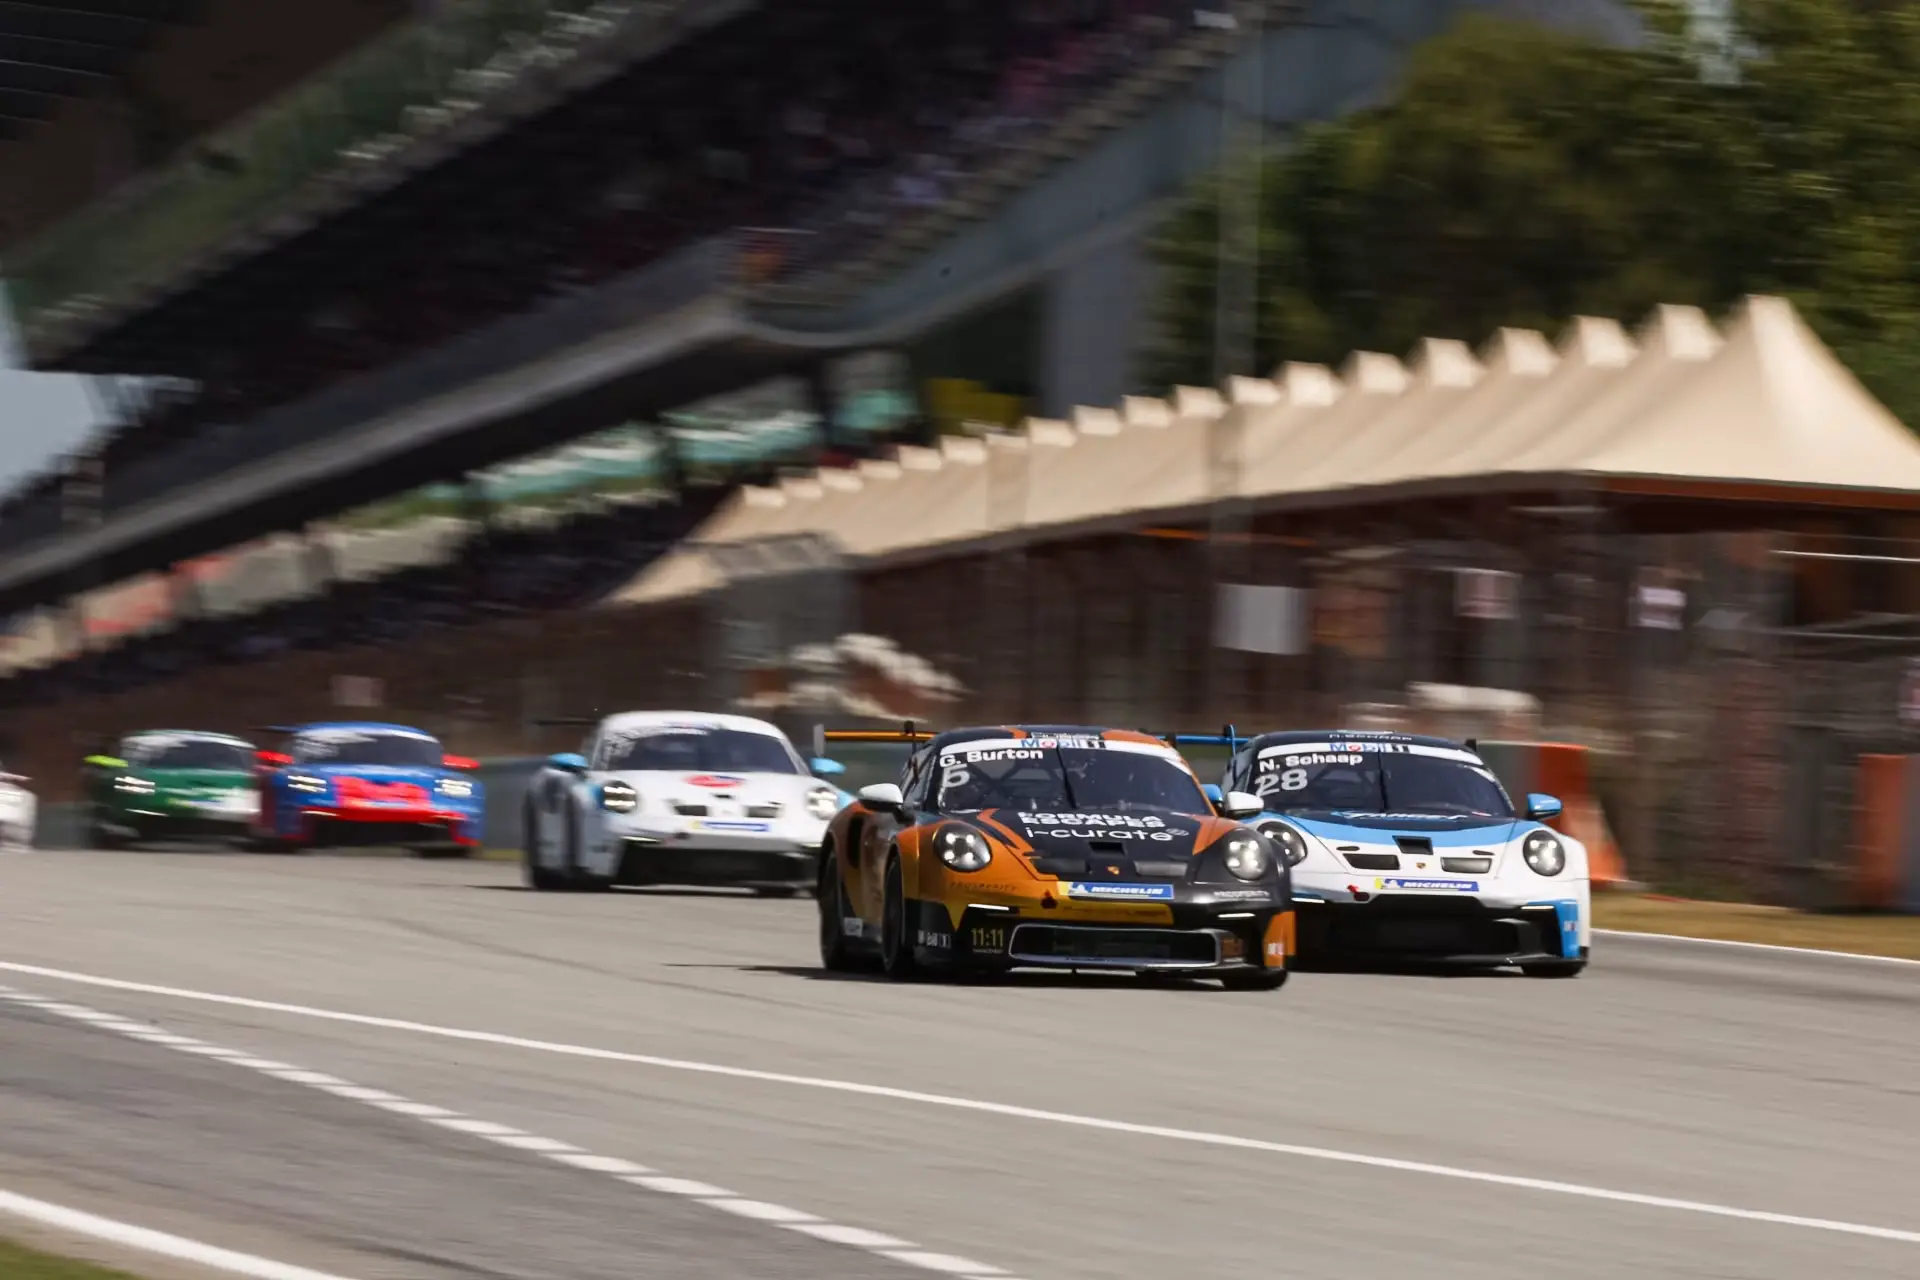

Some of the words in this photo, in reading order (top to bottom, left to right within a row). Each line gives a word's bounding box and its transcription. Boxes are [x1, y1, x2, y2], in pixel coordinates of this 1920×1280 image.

[940, 754, 961, 768] G.
[966, 749, 1044, 763] Burton
[1259, 759, 1280, 772] N.
[1285, 753, 1363, 766] Schaap
[1254, 768, 1308, 797] 28
[1091, 886, 1164, 895] MICHELIN
[1404, 881, 1472, 890] MICHELIN
[970, 928, 1004, 948] 11:11
